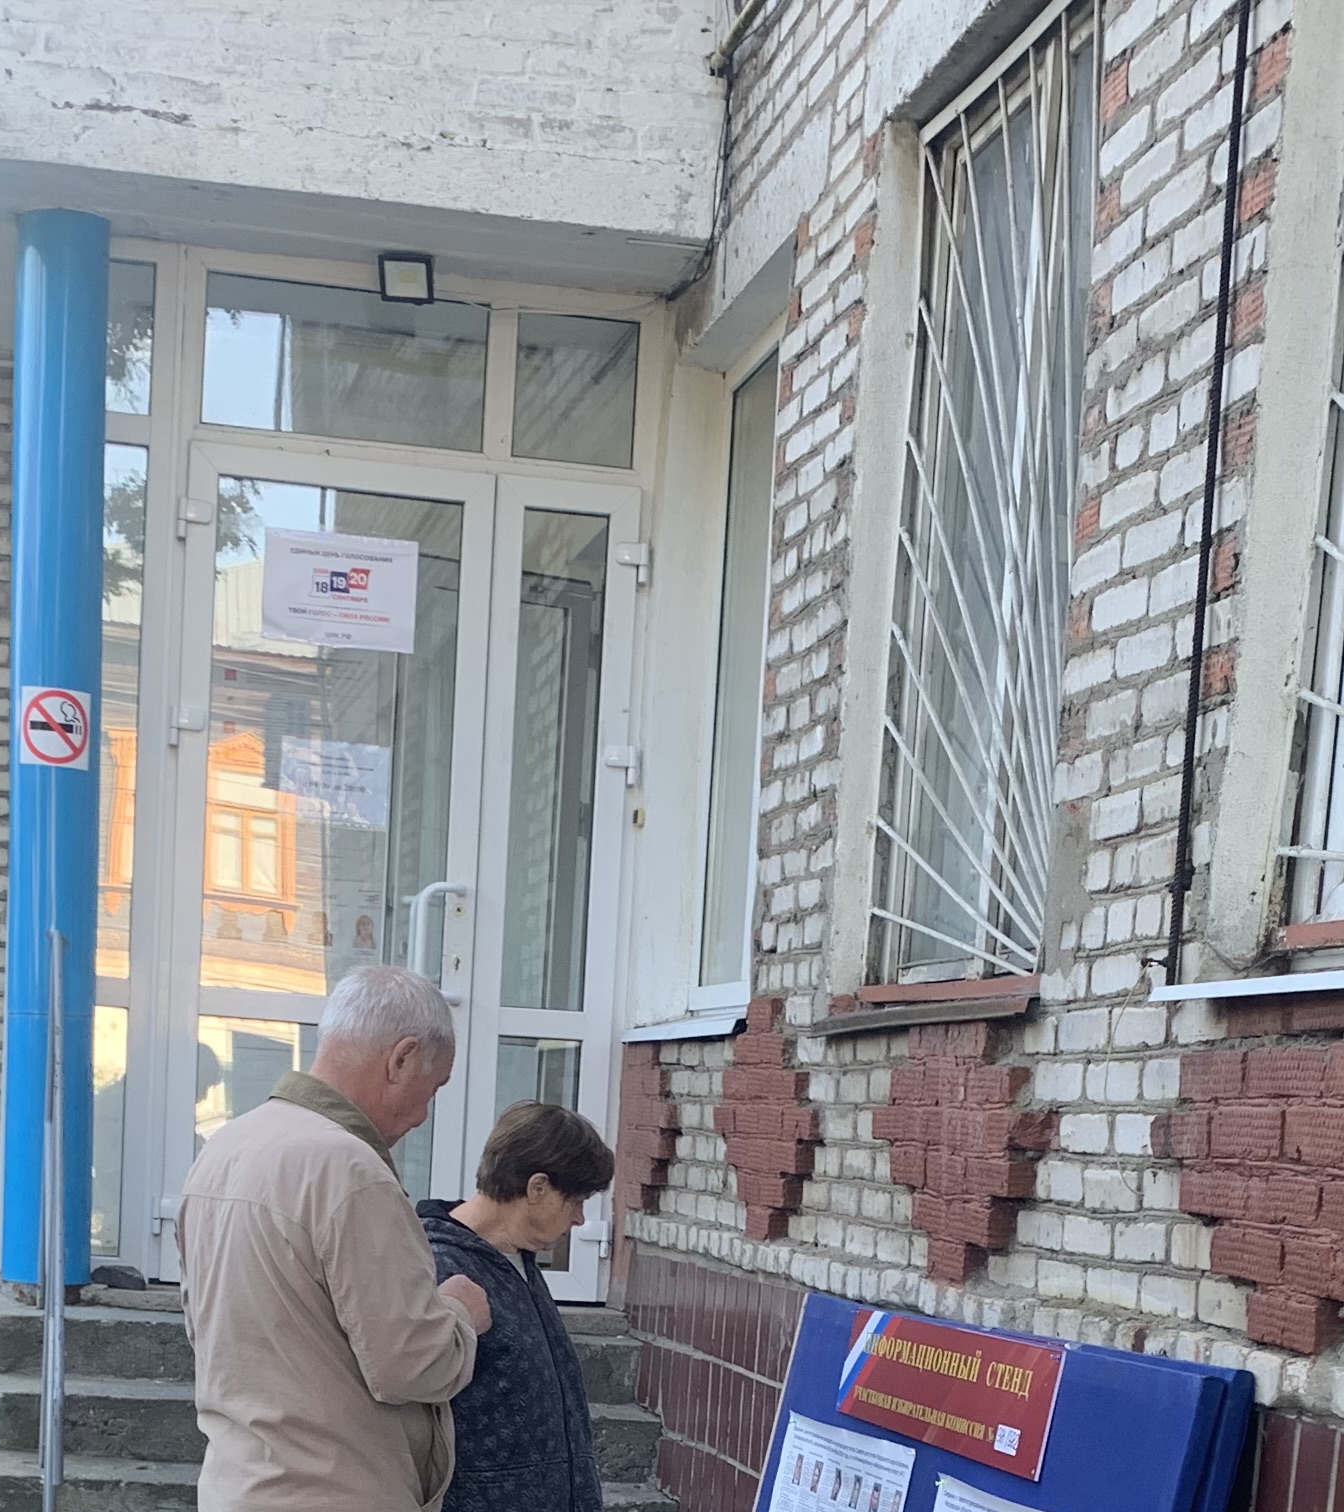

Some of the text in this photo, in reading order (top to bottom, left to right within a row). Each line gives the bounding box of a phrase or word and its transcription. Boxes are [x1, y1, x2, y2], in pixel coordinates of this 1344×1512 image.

[321, 550, 340, 559] ДЕНЬ
[332, 576, 346, 589] 19
[349, 571, 367, 586] 20
[315, 581, 328, 593] 18
[332, 594, 368, 603] СЕНТЯБРЯ
[288, 606, 307, 615] ТВОЙ
[864, 1331, 1034, 1401] ИНФОРМАЦИОННЫЙ СТЕНД
[853, 1385, 892, 1409] УЧАСТКОВАЯ
[891, 1397, 947, 1427] ИЗБИРАТЕЛЬНАЯ
[945, 1413, 986, 1440] КОМИССИЯ
